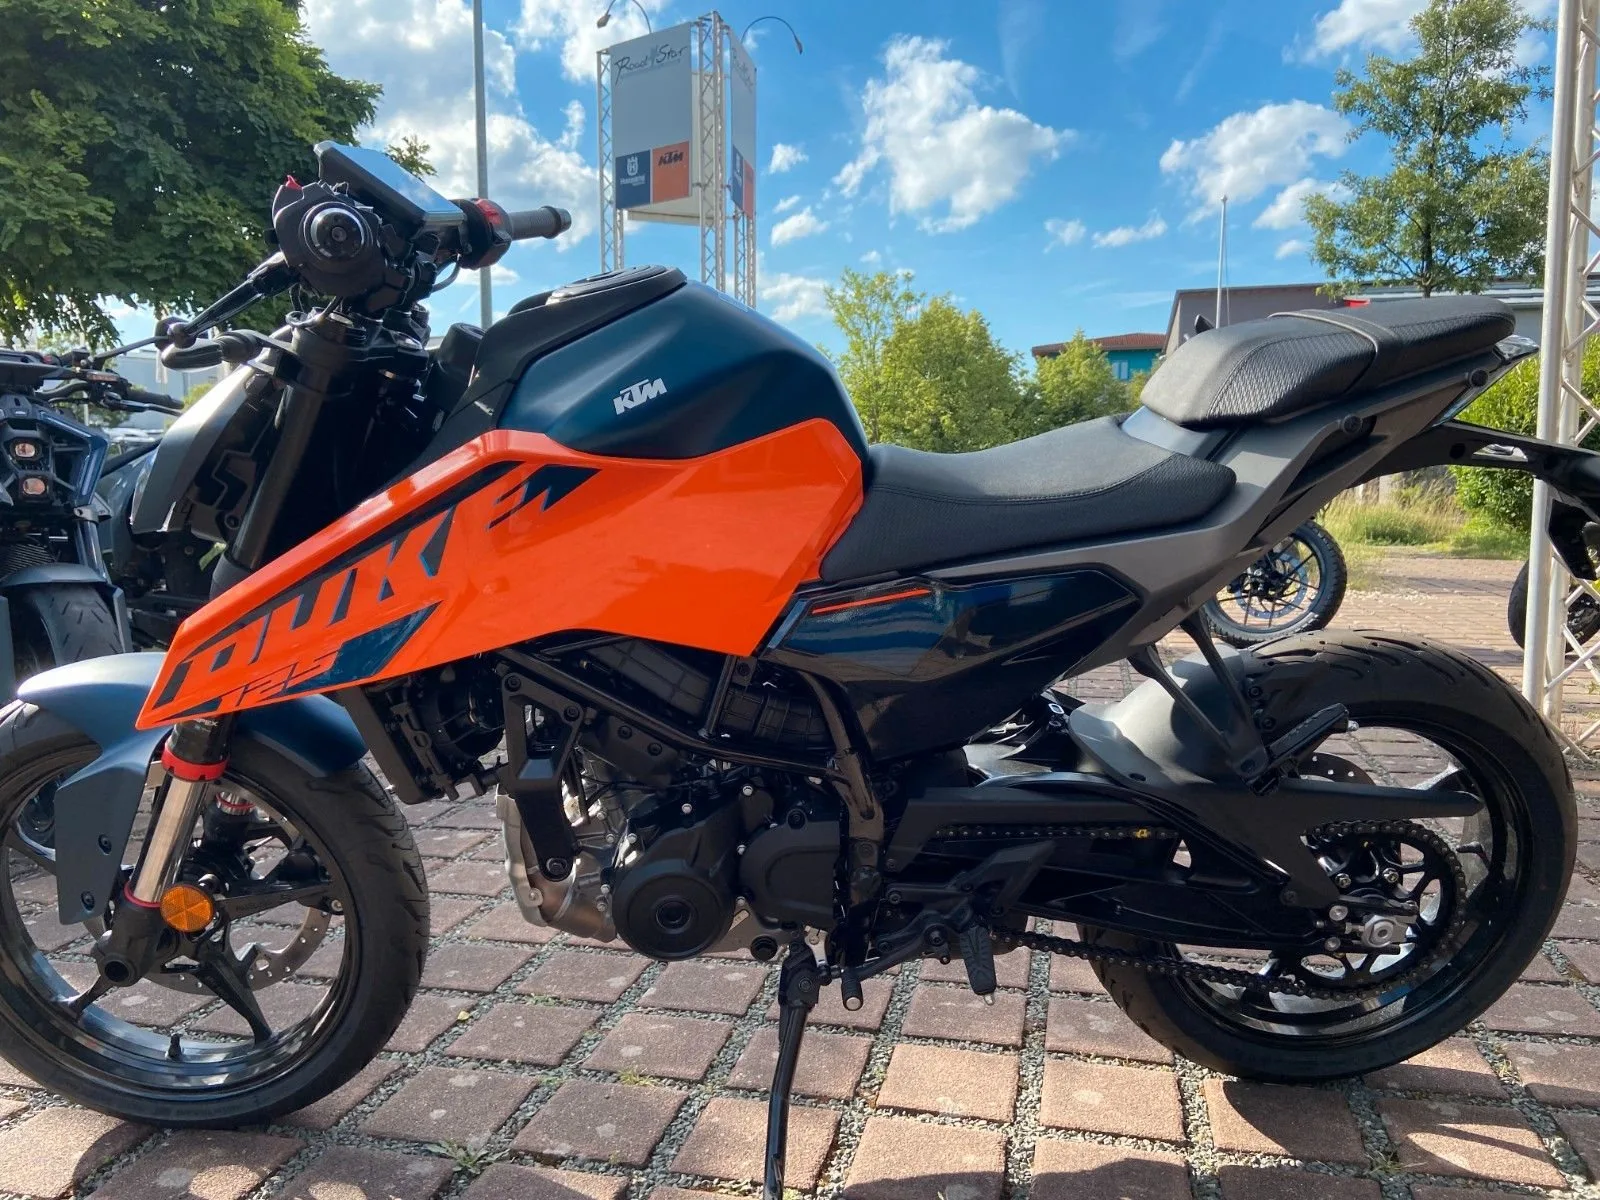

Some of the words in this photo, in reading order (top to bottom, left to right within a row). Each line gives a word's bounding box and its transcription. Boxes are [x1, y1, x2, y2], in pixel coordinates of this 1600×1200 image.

[614, 56, 648, 85] Road
[656, 44, 688, 63] Star
[658, 150, 684, 166] KTM
[613, 378, 667, 415] KTM
[165, 465, 548, 704] DUKE
[216, 650, 339, 712] 125
